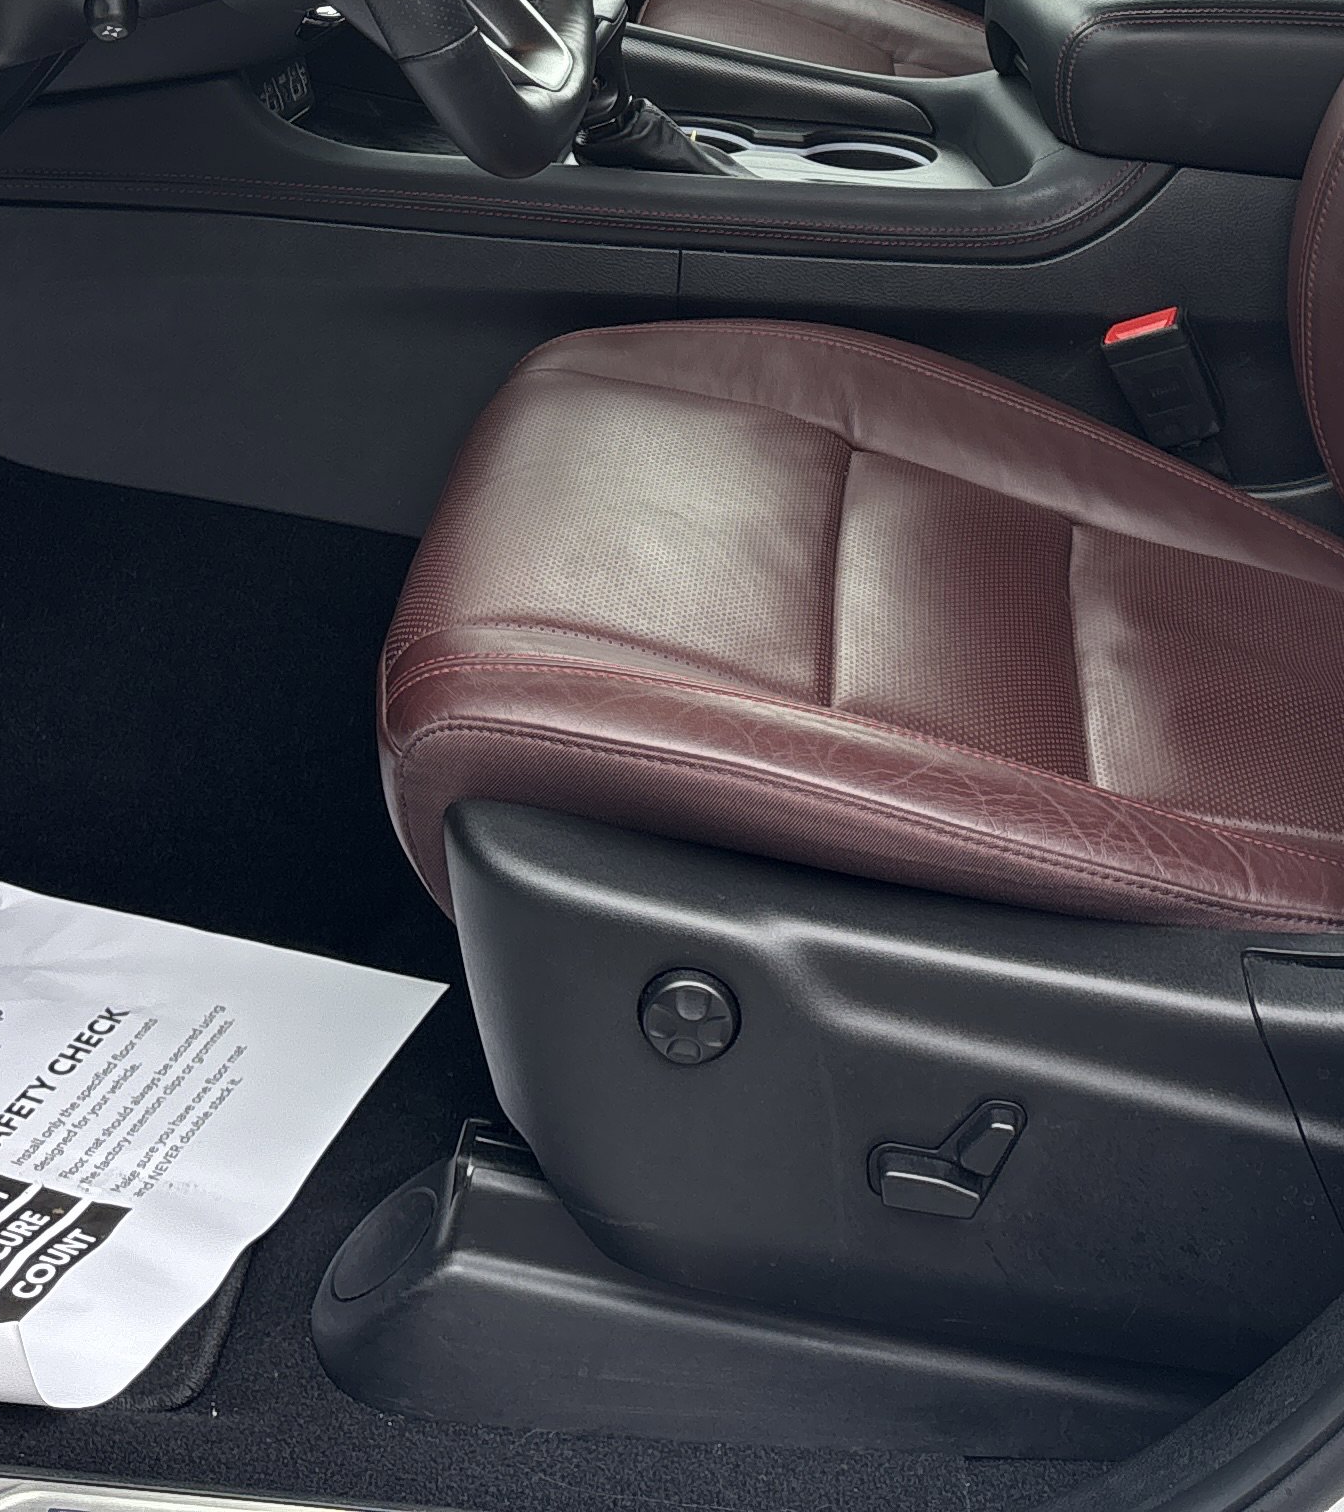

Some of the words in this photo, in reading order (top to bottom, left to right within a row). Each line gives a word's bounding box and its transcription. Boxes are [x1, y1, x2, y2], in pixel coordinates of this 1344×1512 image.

[47, 1007, 131, 1076] CHECK
[11, 1137, 46, 1166] Install
[59, 1101, 81, 1119] the
[33, 1129, 78, 1171] designed
[71, 1115, 90, 1130] for
[87, 1094, 110, 1117] your
[94, 1136, 132, 1171] factory
[136, 1145, 159, 1169] sure
[156, 1126, 175, 1146] you
[148, 1144, 184, 1181] NEVER
[179, 1110, 213, 1145] double
[11, 1228, 96, 1299] COUNT
